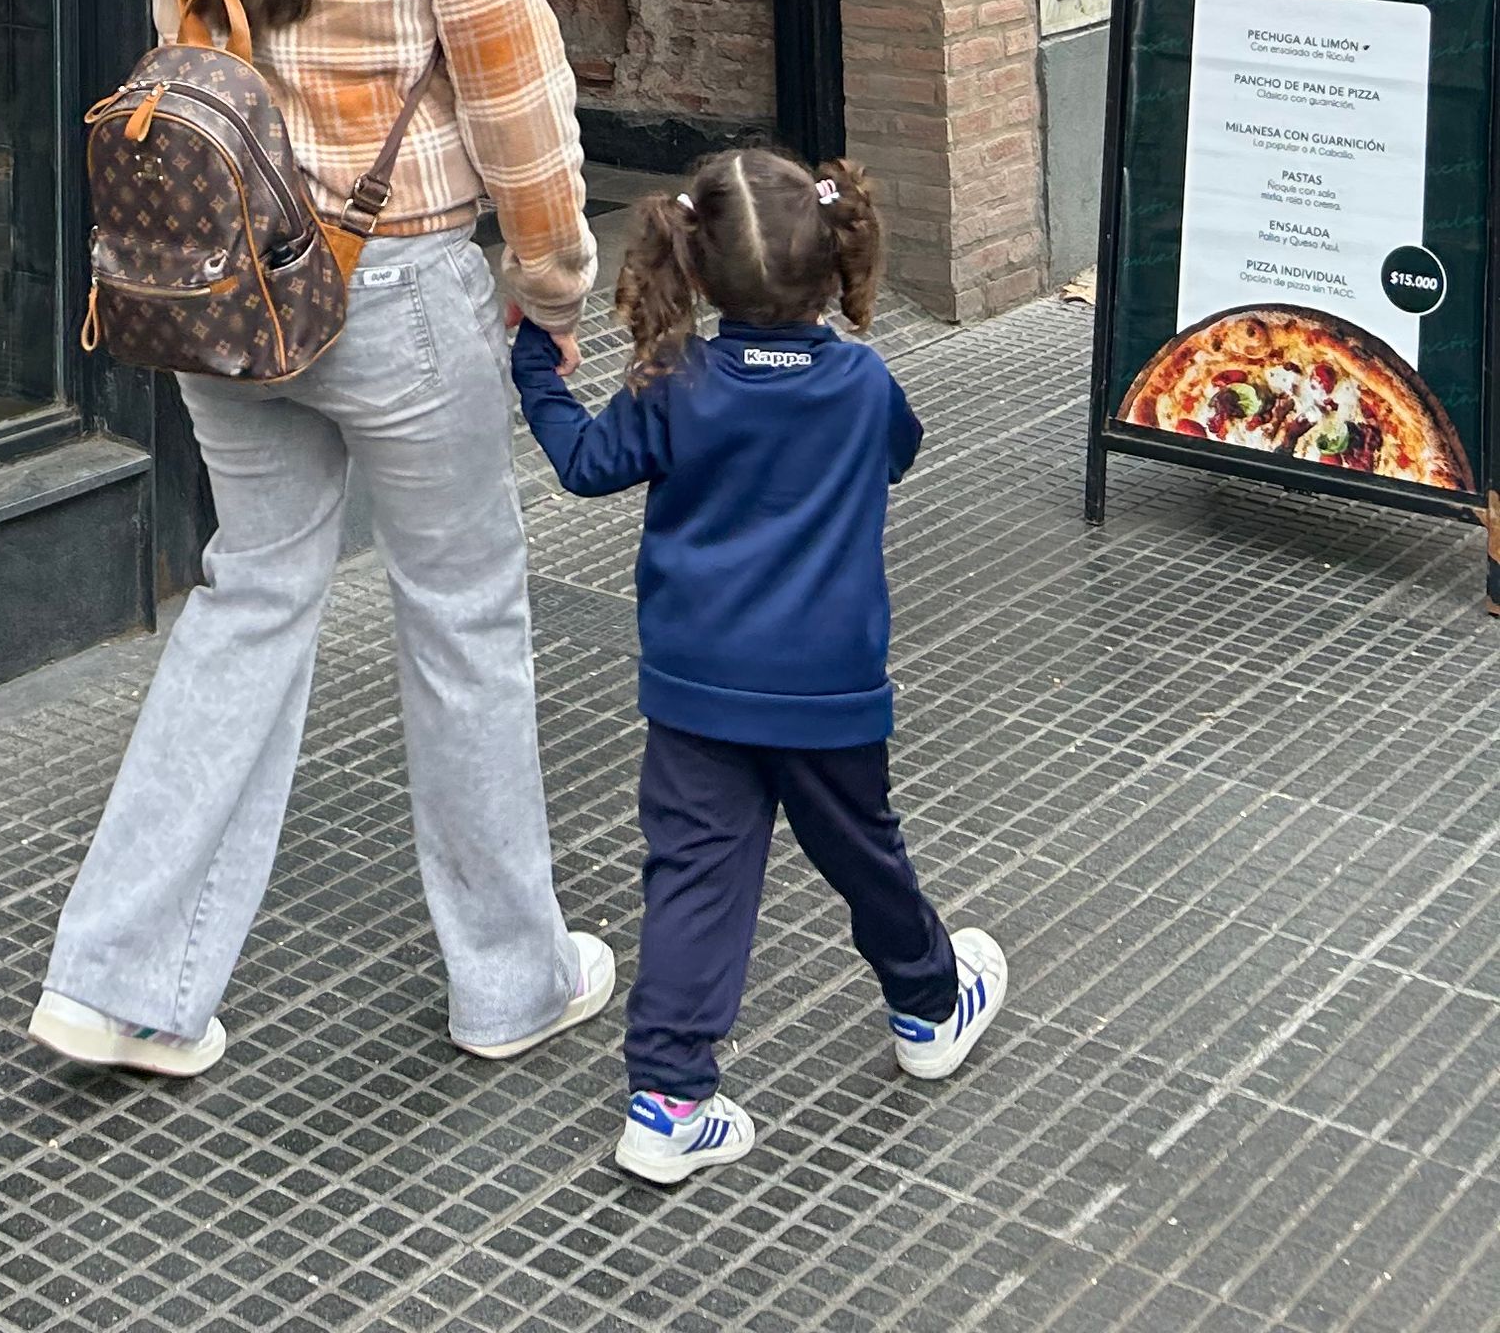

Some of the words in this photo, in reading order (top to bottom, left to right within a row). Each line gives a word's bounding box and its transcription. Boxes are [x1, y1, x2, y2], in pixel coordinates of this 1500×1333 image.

[1247, 29, 1300, 45] PECHUGA
[1304, 36, 1318, 47] AL
[1321, 37, 1359, 51] LIMÓN
[1250, 41, 1268, 53] Con
[1270, 45, 1310, 58] ensalada
[1312, 49, 1324, 59] de
[1234, 74, 1281, 89] PANCHO
[1284, 79, 1299, 91] DE
[1302, 82, 1325, 95] PAN
[1329, 86, 1344, 97] DE
[1347, 88, 1381, 101] PIZZA
[1256, 88, 1289, 101] Clásico
[1290, 94, 1307, 103] con
[1225, 121, 1281, 138] MILANESA
[1284, 130, 1308, 142] CON
[1311, 133, 1385, 152] GUARNICIÓN
[1252, 138, 1264, 148] La
[1265, 140, 1300, 152] popular
[1309, 145, 1317, 155] A
[1282, 170, 1322, 186] PASTAS
[1298, 186, 1316, 196] con
[1304, 199, 1311, 207] o
[1269, 220, 1330, 239] ENSALADA
[1281, 237, 1288, 245] y
[1289, 236, 1318, 249] Queso
[1246, 259, 1278, 274] PIZZA
[1281, 265, 1348, 286] INDIVIDUAL
[1389, 270, 1438, 291] $15.000
[1239, 271, 1272, 285] Opción
[1274, 277, 1285, 287] de
[1287, 280, 1310, 293] pizza
[745, 350, 811, 366] Kappa
